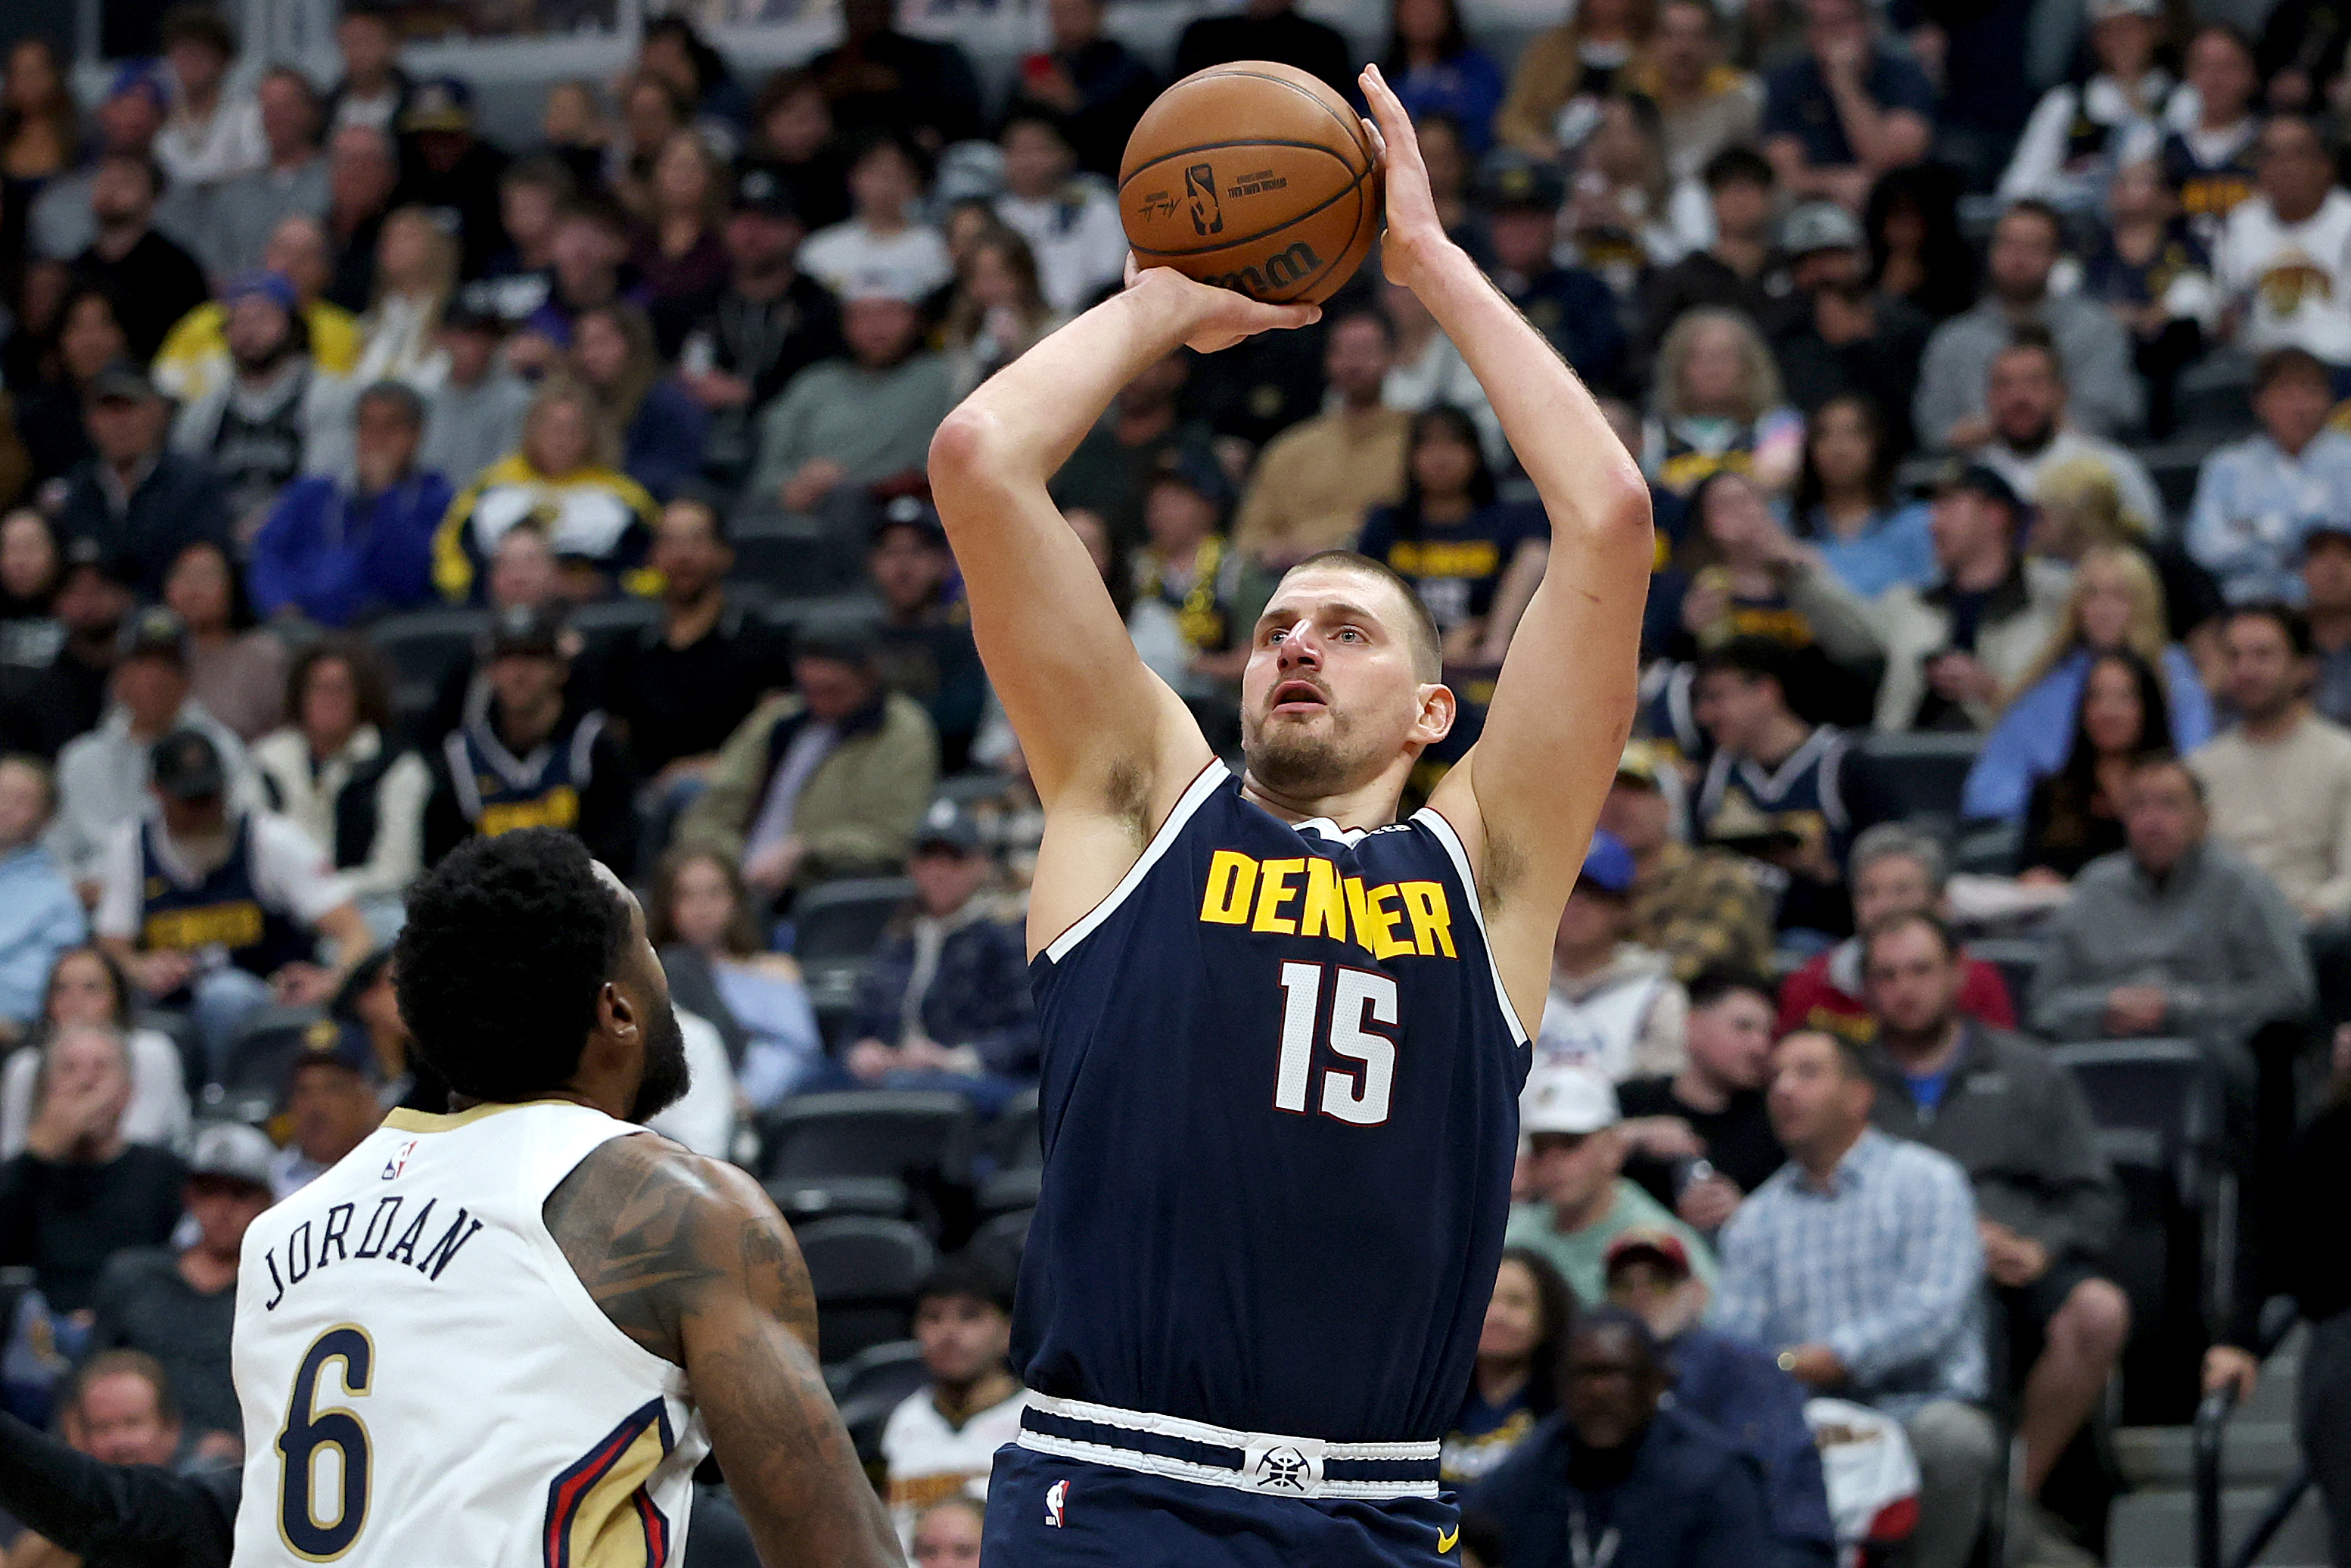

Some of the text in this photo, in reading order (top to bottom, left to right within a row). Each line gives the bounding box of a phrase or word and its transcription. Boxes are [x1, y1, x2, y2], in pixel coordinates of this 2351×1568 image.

[1199, 849, 1459, 960] DENVER
[1272, 958, 1400, 1128] 15
[265, 1196, 484, 1311] JORDAN
[274, 1322, 376, 1563] 6
